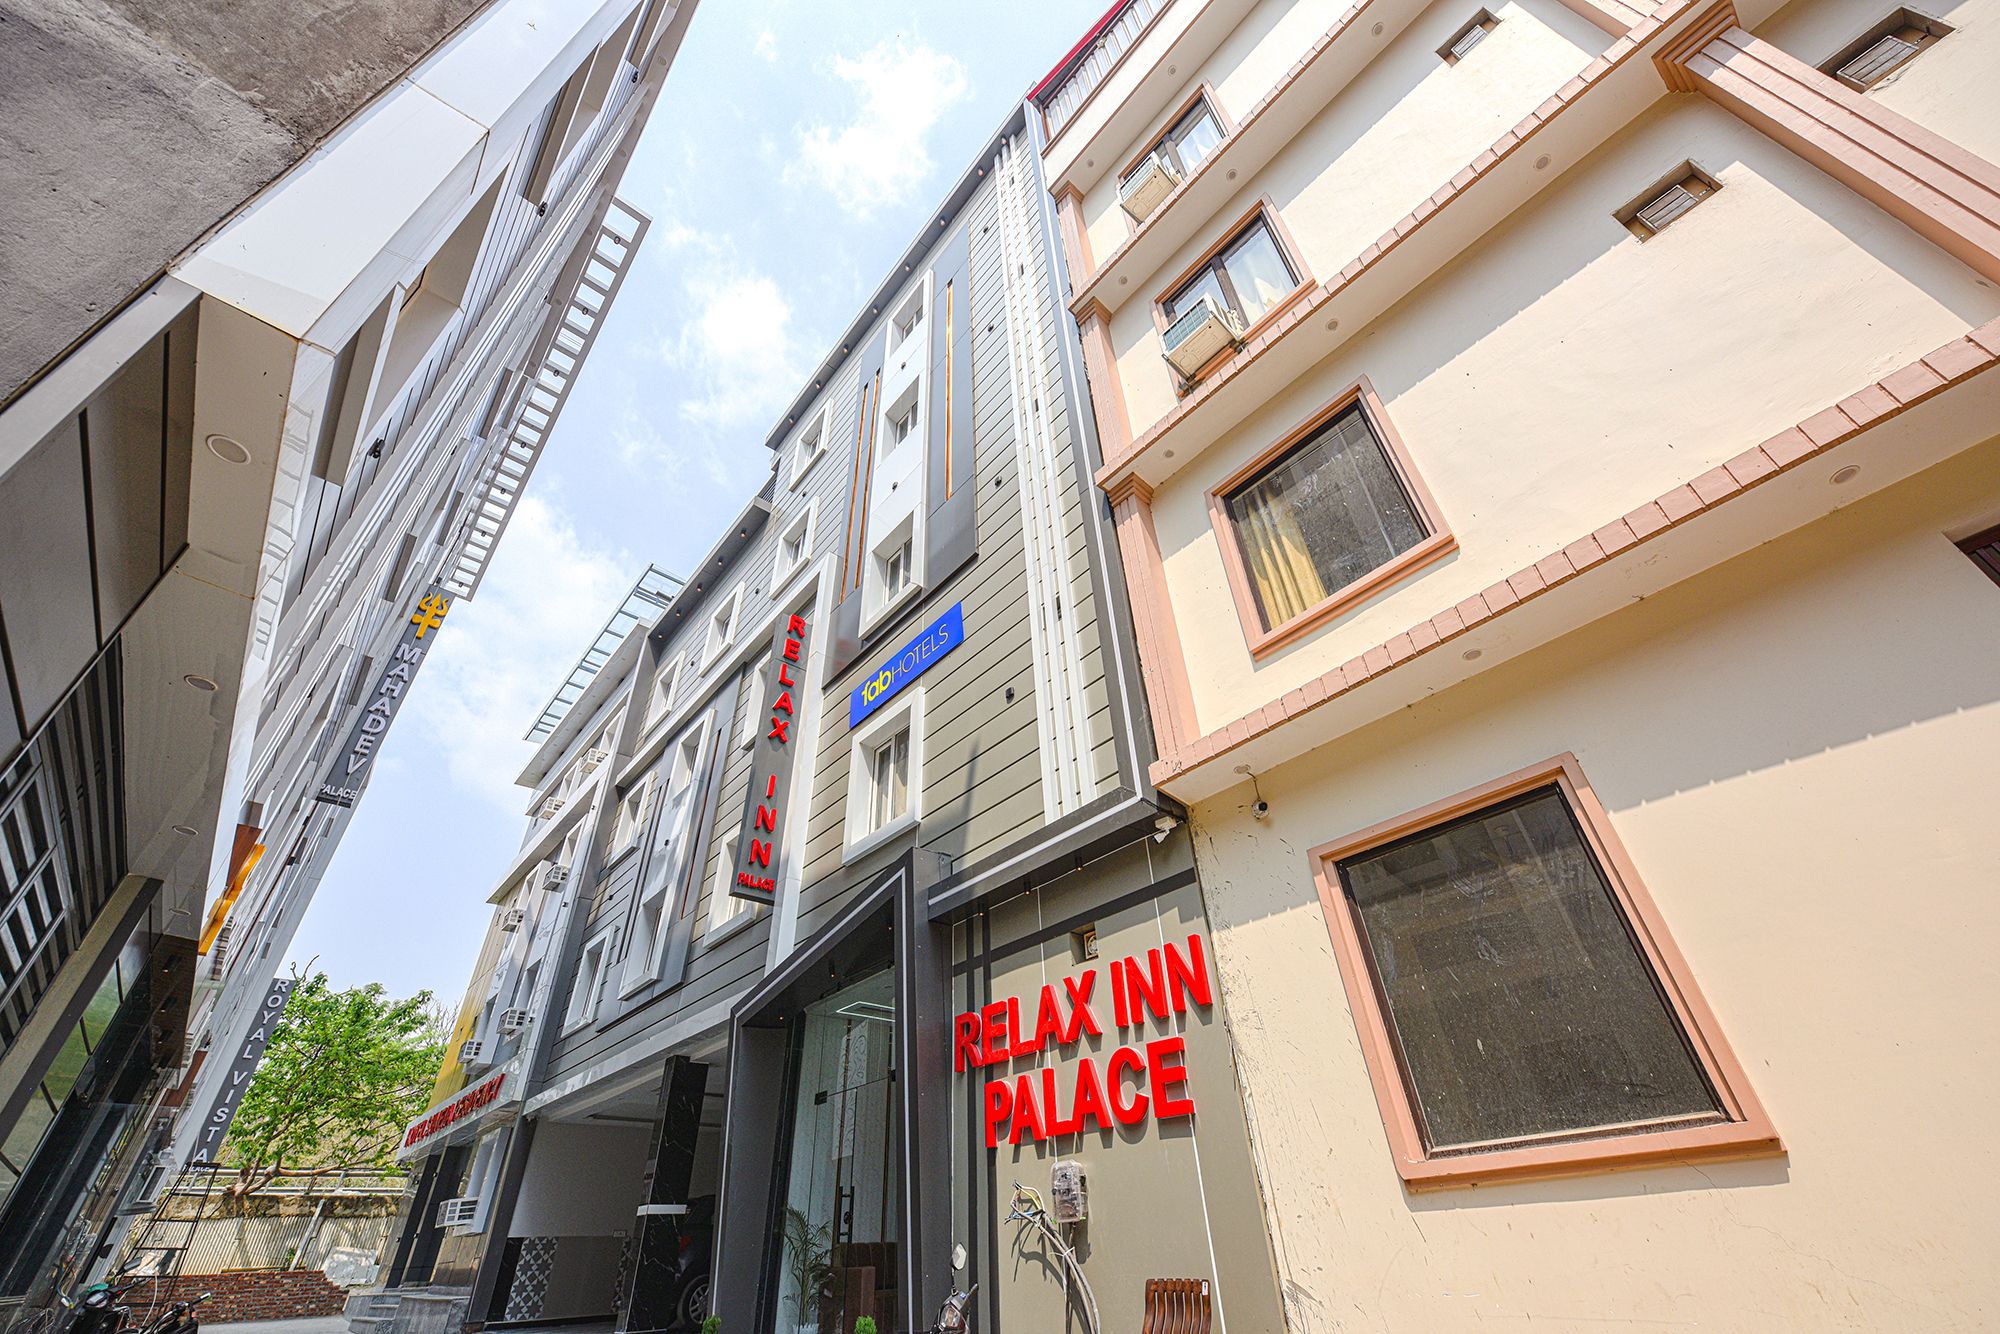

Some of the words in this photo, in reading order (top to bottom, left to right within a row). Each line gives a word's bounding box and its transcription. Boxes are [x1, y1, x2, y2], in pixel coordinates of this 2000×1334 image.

[346, 642, 423, 775] MAHADEV
[768, 614, 806, 743] RELAX
[320, 783, 357, 799] PALACE
[749, 774, 777, 867] INN
[737, 871, 776, 892] PALACE
[242, 978, 290, 1059] ROYAL
[954, 969, 1103, 1072] RELAX
[1109, 933, 1213, 1028] INN
[193, 1070, 248, 1163] VISTA
[984, 1036, 1195, 1148] PALACE
